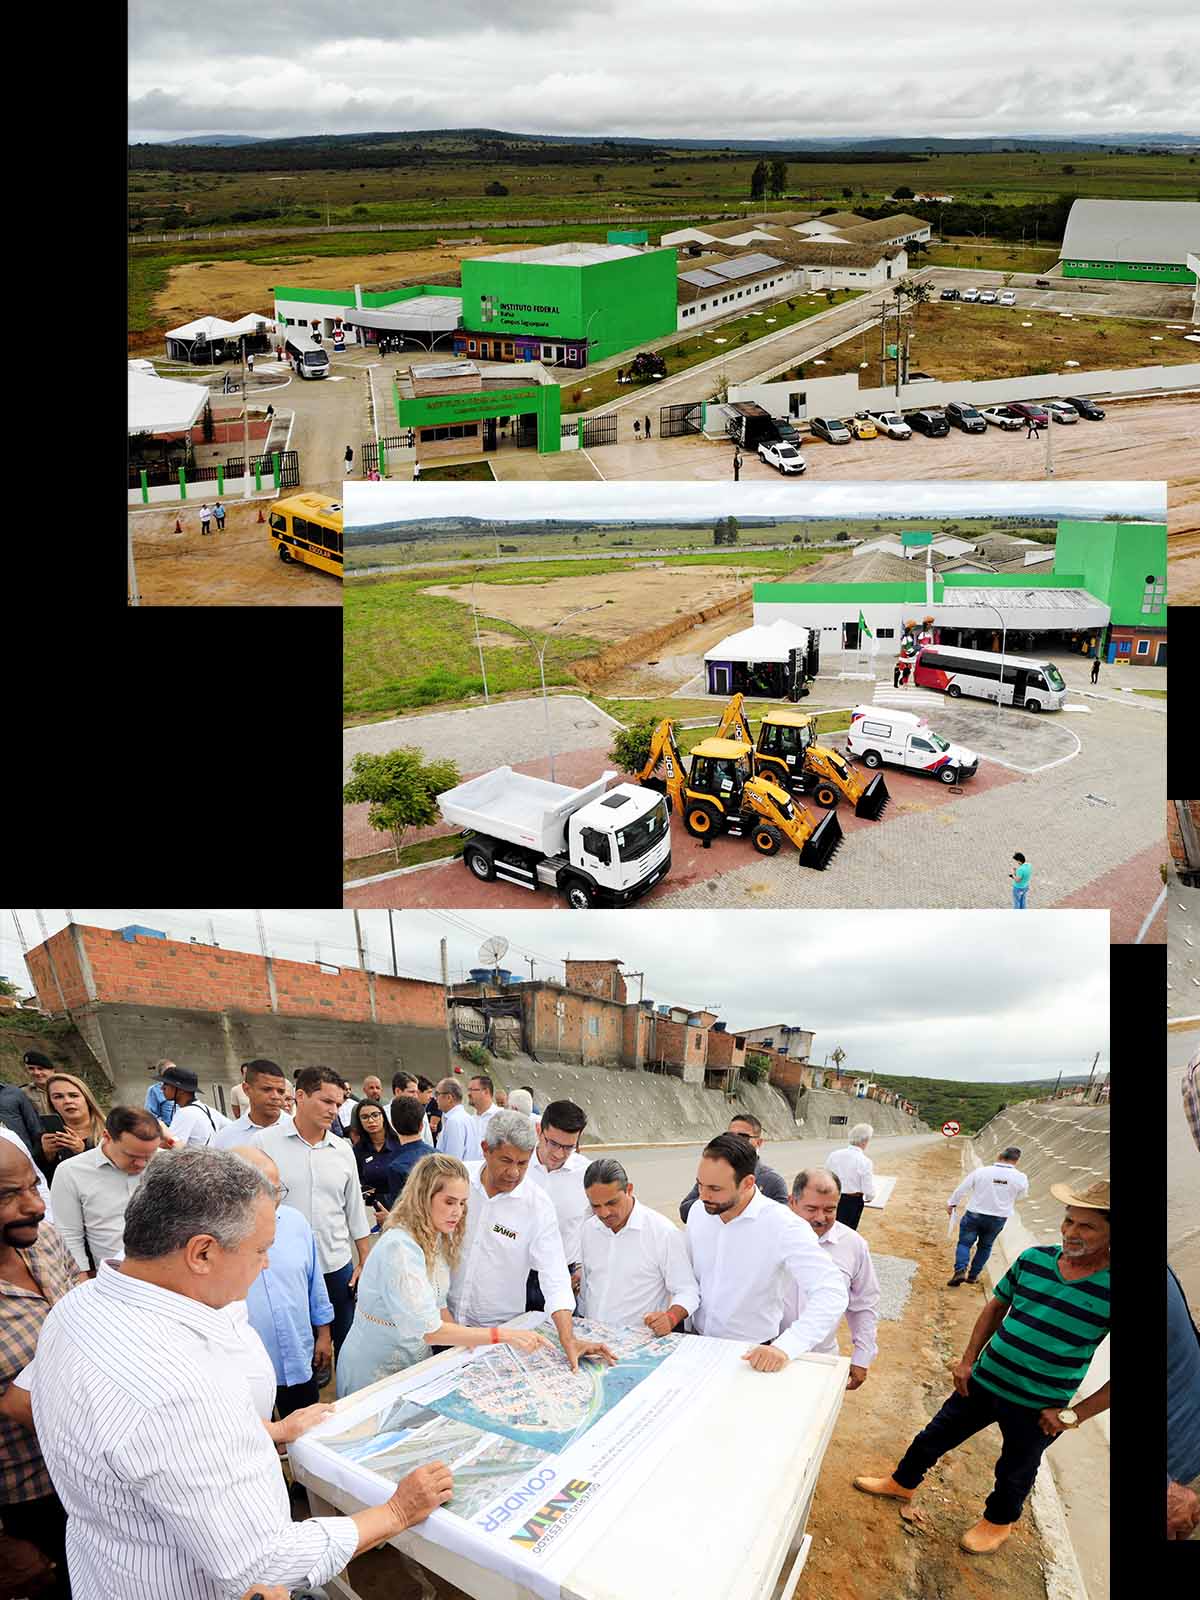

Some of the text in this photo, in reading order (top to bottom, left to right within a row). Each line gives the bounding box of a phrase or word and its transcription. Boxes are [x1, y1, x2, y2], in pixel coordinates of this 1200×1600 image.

[500, 303, 560, 314] INSTITUTO FEDERAL
[478, 1468, 556, 1532] CONDER
[509, 1479, 592, 1550] BAHIA
